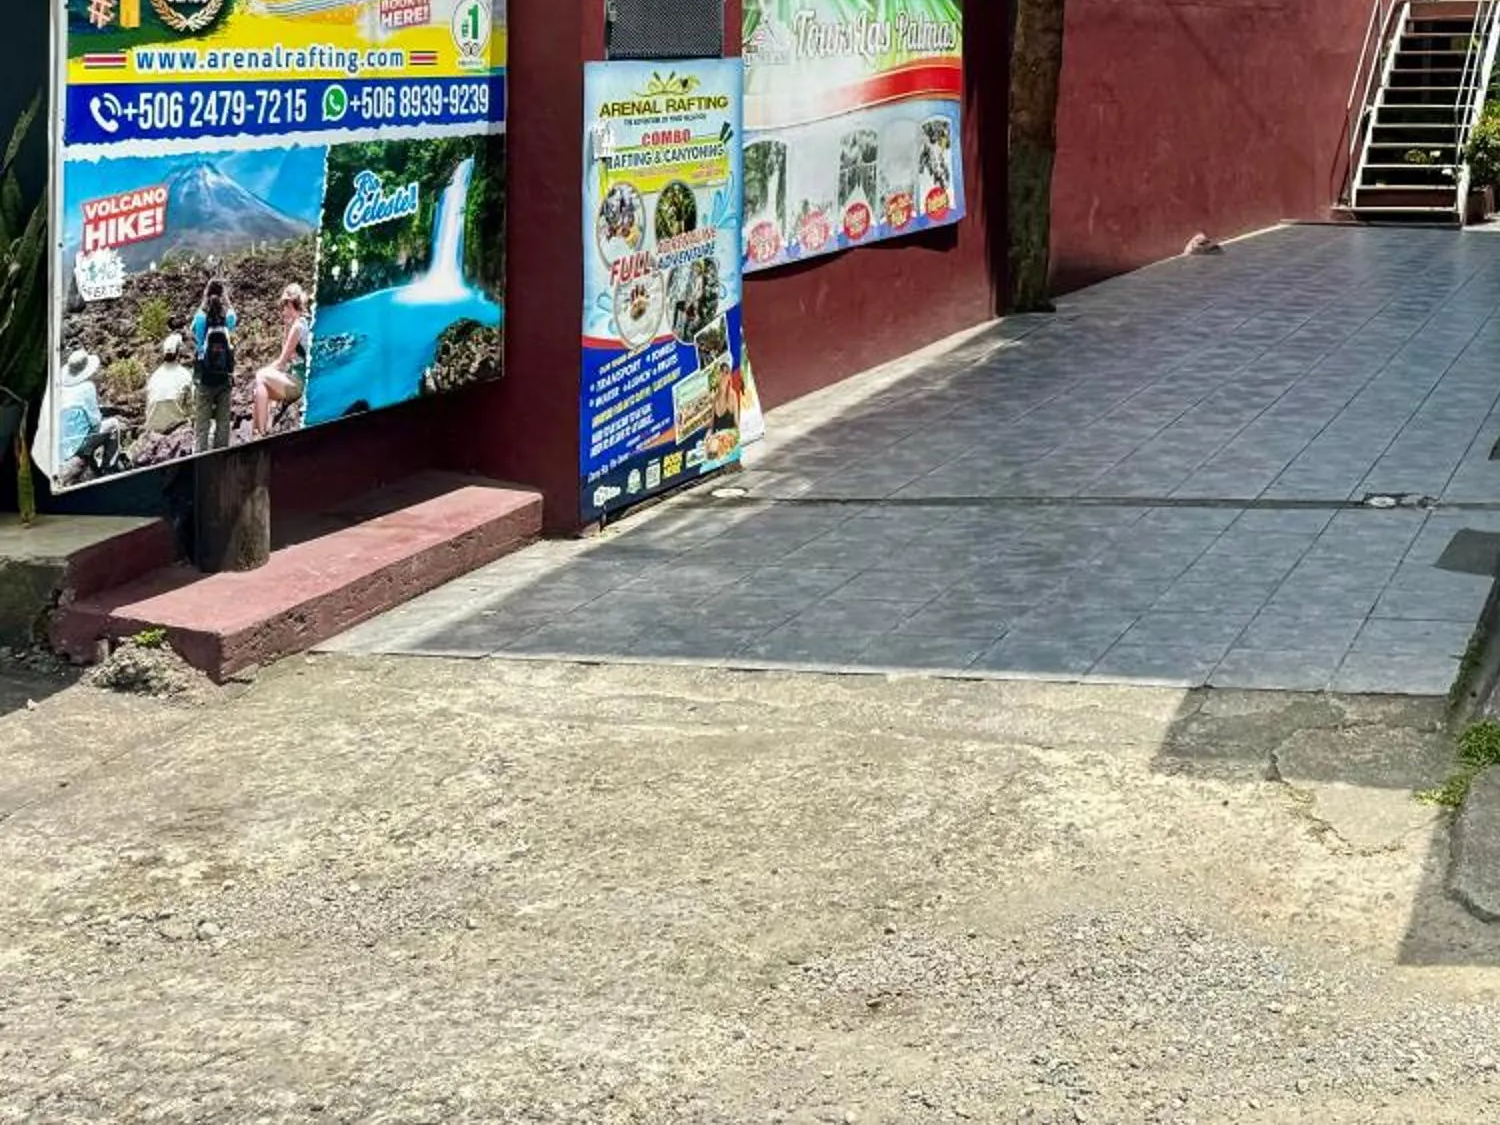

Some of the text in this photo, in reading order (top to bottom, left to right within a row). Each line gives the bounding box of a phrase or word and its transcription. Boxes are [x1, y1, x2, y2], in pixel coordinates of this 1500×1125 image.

[380, 8, 430, 28] HERE!
[896, 10, 957, 53] Palmas
[136, 47, 404, 73] www.arenalrafting.com
[123, 83, 490, 130] +506 2479-7215 +506 8939-9239
[599, 96, 729, 117] ARENAL RAFTING
[640, 128, 692, 148] COMBO
[85, 187, 168, 221] VOLCANO
[85, 208, 164, 251] HIKE!
